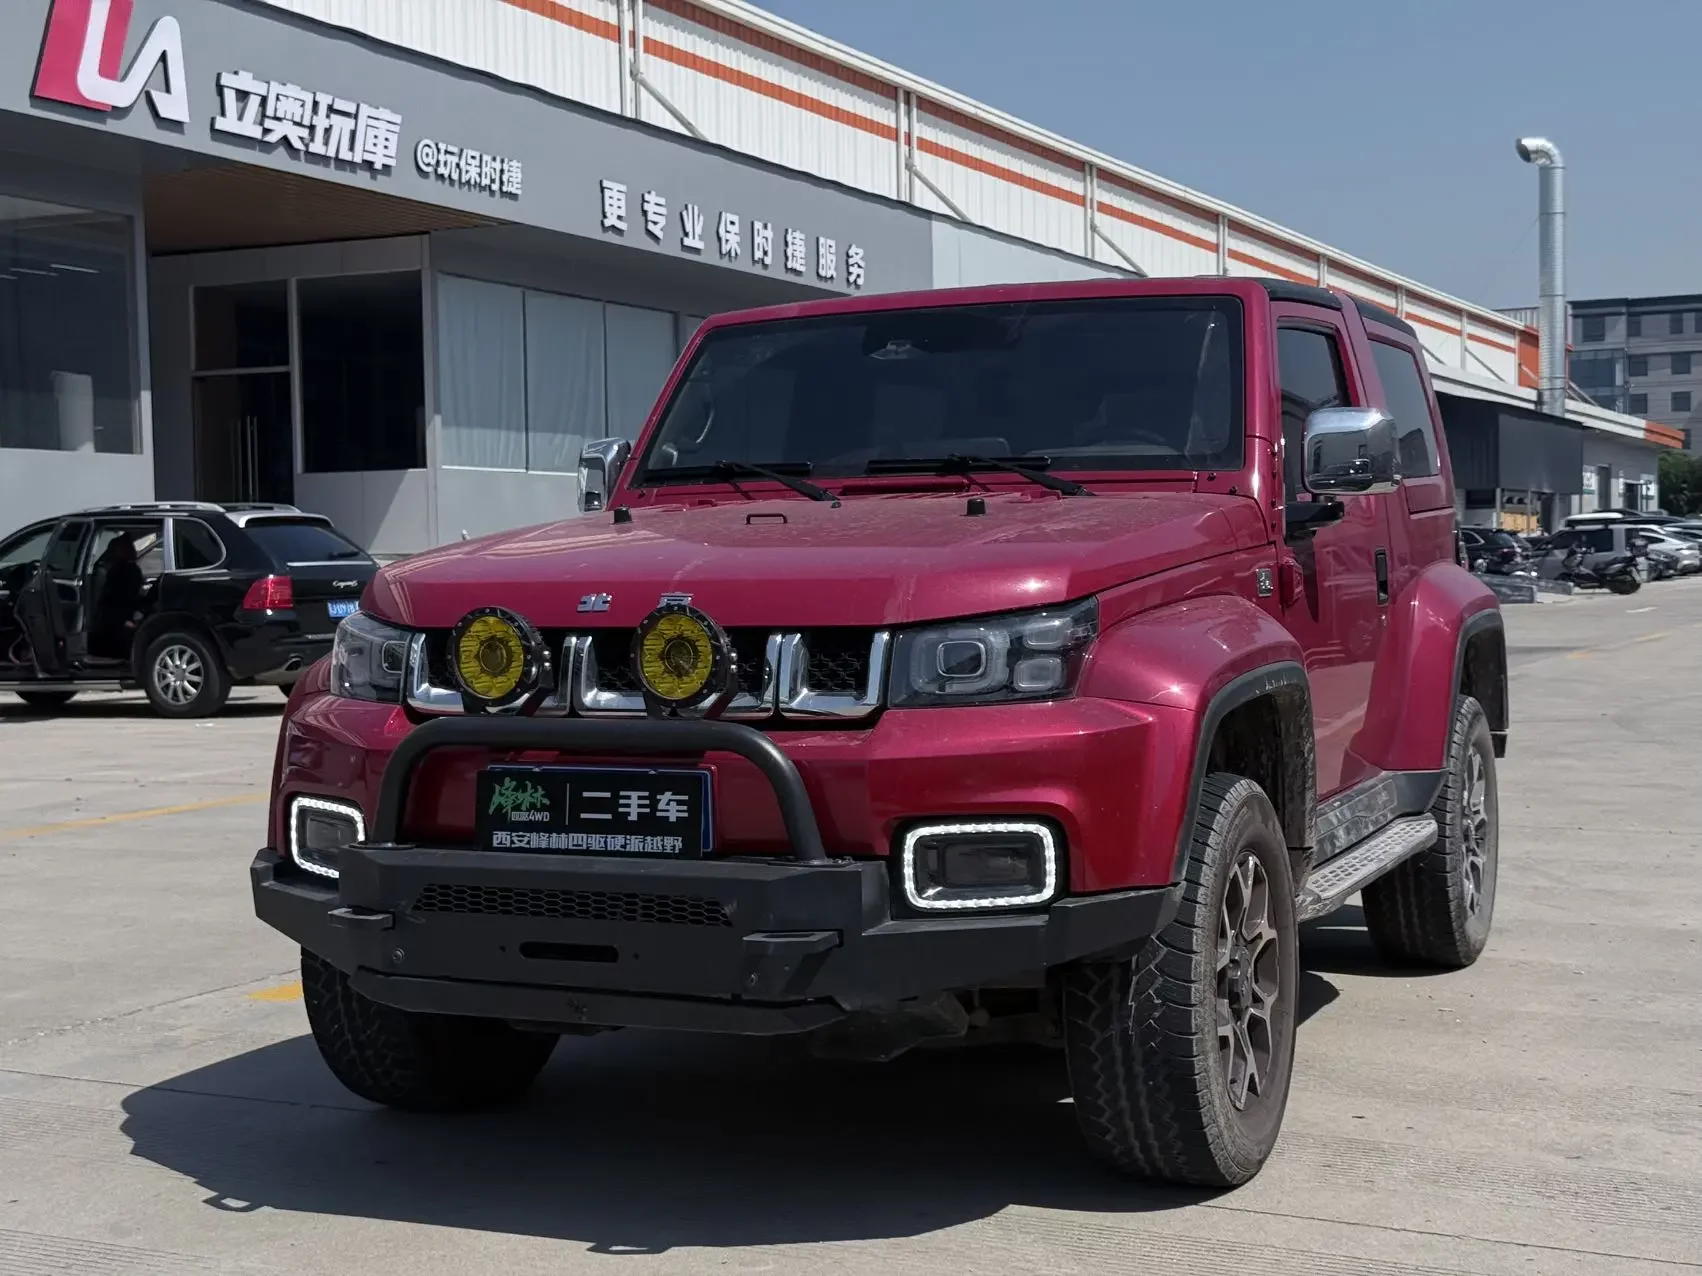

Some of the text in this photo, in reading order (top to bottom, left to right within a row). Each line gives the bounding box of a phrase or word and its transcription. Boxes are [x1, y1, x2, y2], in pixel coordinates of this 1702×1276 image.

[416, 138, 522, 195] @玩保时捷
[600, 179, 865, 285] 更专业保时捷服务
[580, 791, 689, 822] 二手车
[492, 831, 683, 854] 西安峰林四驱硬派越野
